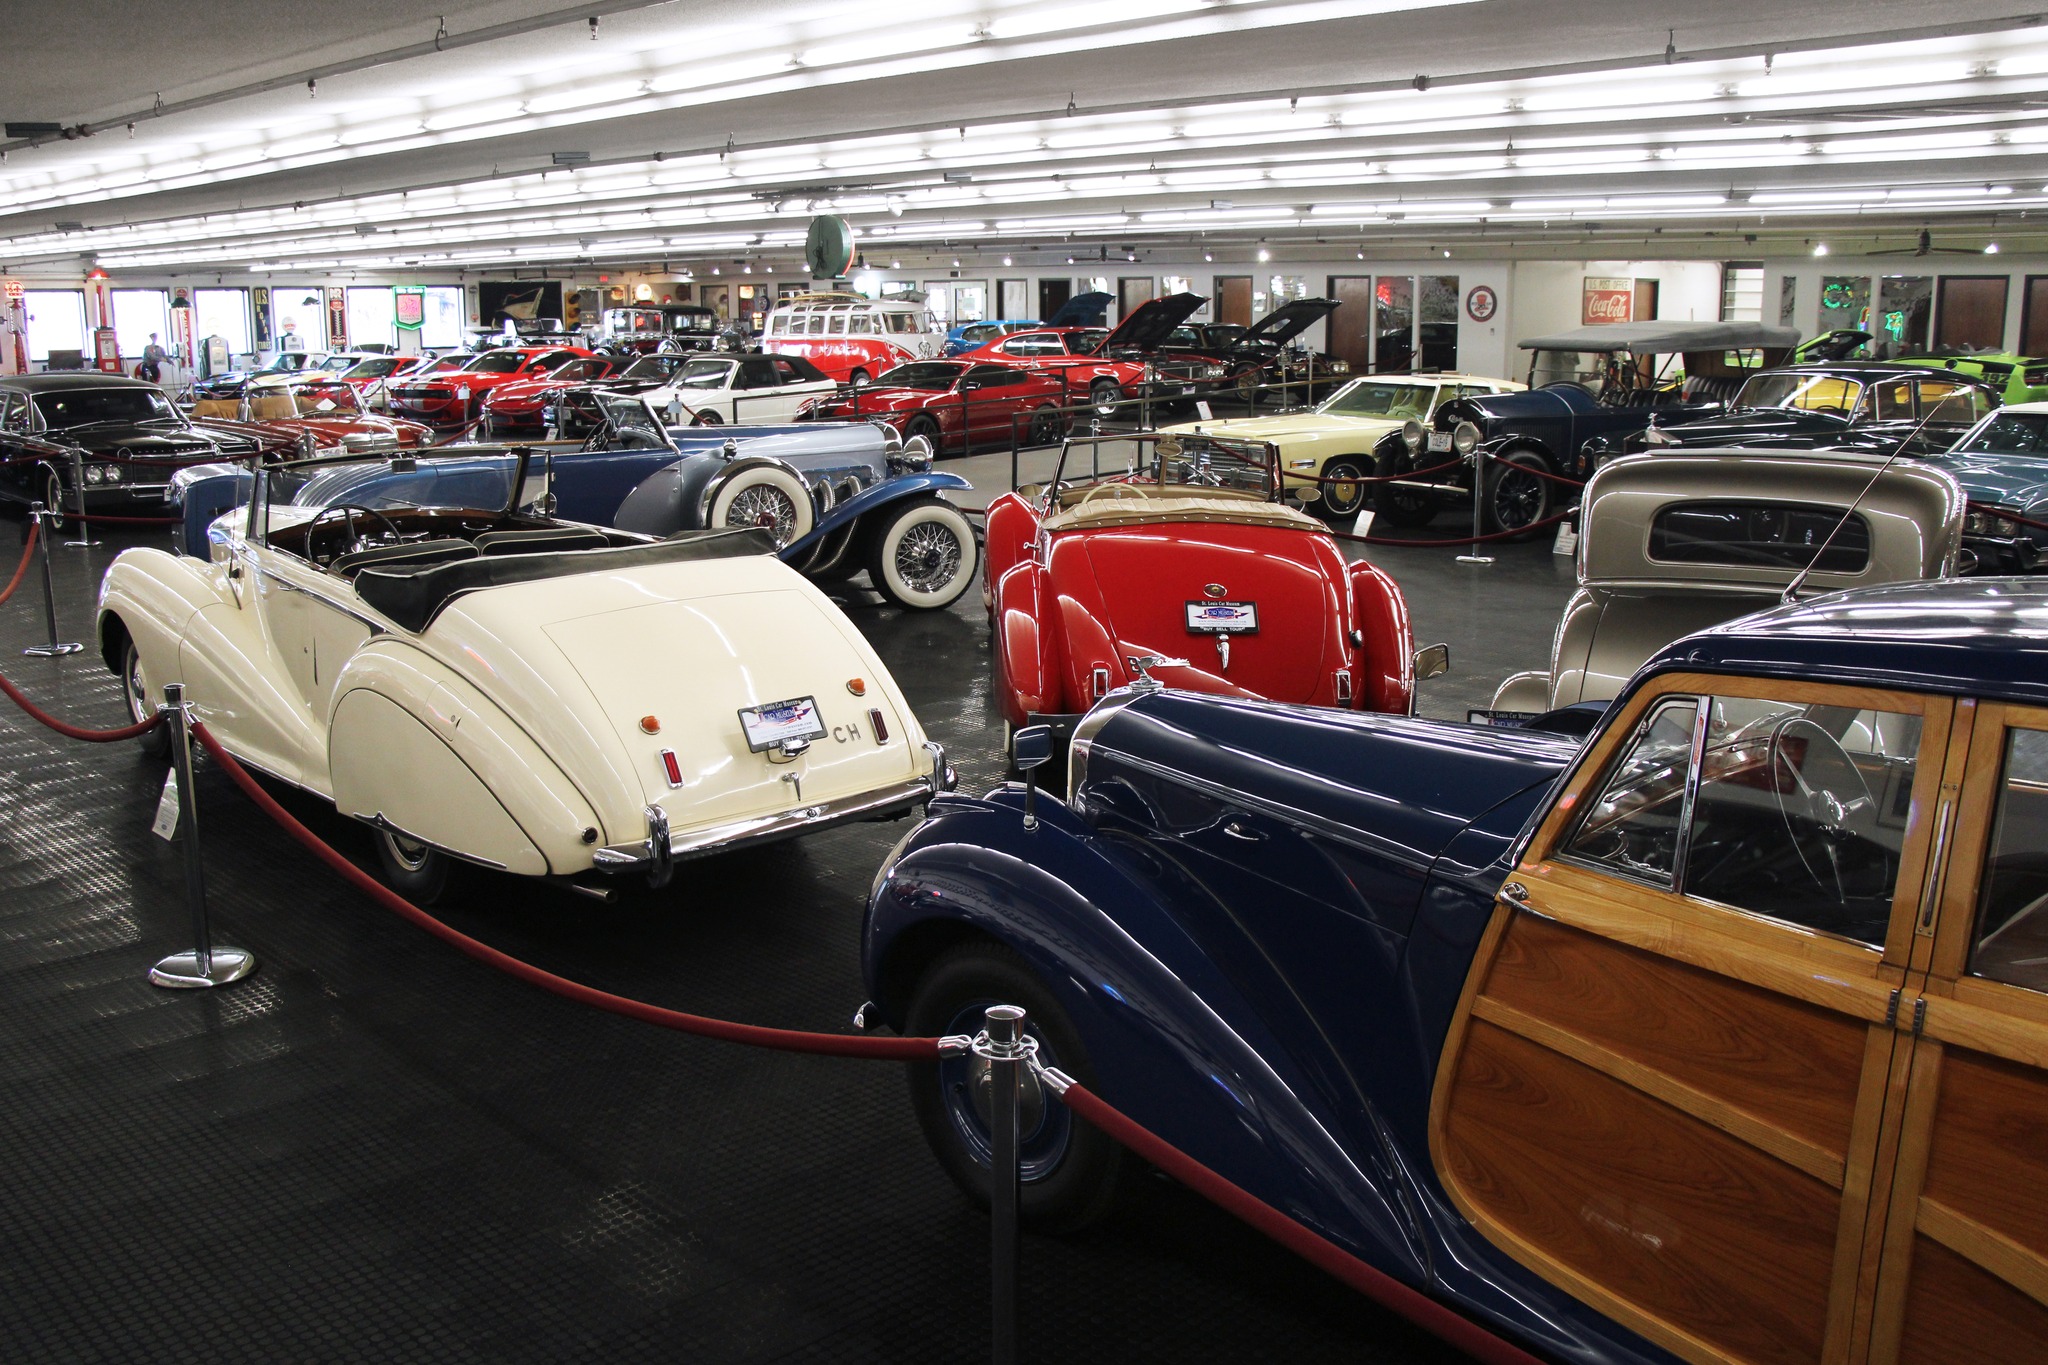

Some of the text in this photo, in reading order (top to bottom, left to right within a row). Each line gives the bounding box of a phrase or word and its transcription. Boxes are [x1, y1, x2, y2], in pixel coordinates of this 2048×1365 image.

[254, 289, 269, 305] U.S.
[1588, 294, 1628, 318] Coca-Cola
[833, 723, 861, 743] CH
